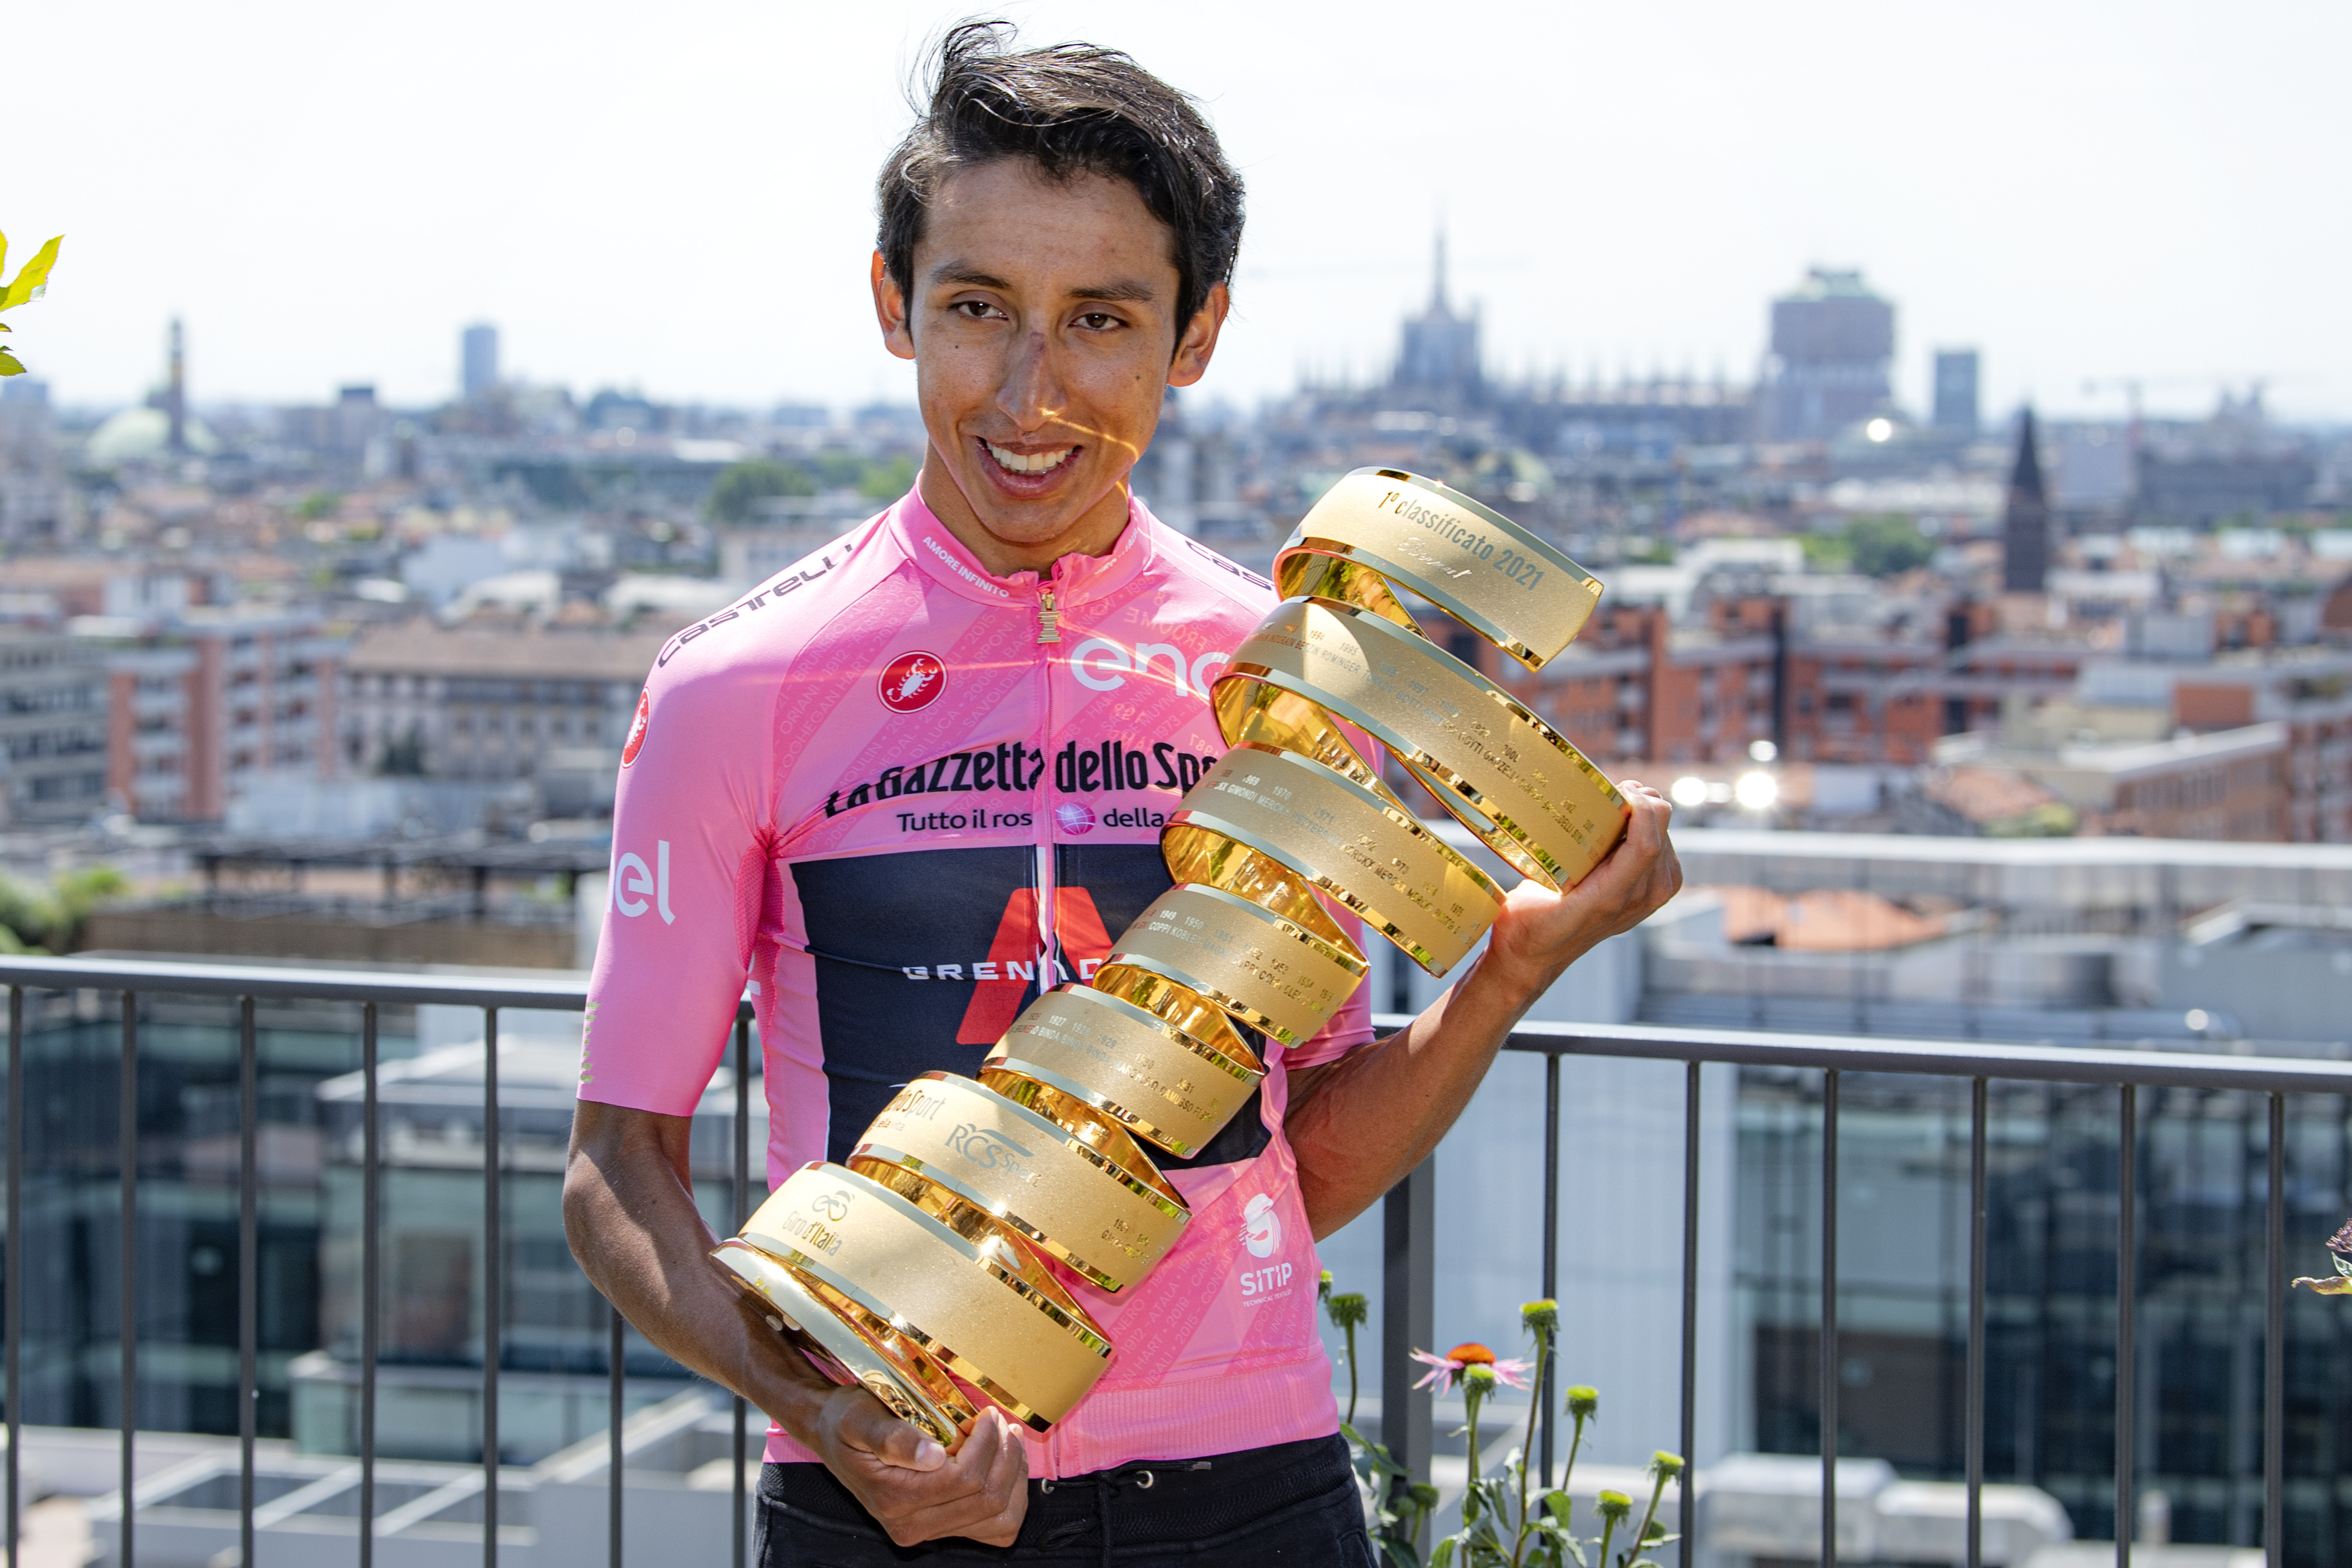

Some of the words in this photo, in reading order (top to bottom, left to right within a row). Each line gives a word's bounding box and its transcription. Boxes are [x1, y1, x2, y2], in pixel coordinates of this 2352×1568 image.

[1395, 499, 1495, 561] classificato
[1492, 549, 1545, 591] 2021
[923, 536, 960, 571] AMORE
[957, 566, 1010, 597] INFINITO
[965, 613, 996, 645] 2015
[1340, 641, 1359, 656] 1995
[836, 653, 871, 691] HART
[950, 620, 1018, 689] SCARPONI
[1321, 649, 1361, 675] ROMINGER
[780, 684, 821, 734] ORIANI
[821, 649, 848, 677] 1912
[910, 743, 929, 760] DI
[923, 709, 962, 744] LUCA
[963, 667, 999, 702] 2006
[1056, 740, 1149, 793] dello
[1227, 784, 1258, 802] GIMONDI
[1272, 785, 1293, 801] 1970
[897, 812, 966, 832] Tutto
[972, 809, 987, 829] il
[1102, 808, 1163, 828] della
[607, 838, 676, 926] el
[1148, 921, 1172, 934] COPPI
[1159, 909, 1178, 920] 1949
[1183, 916, 1204, 930] 1950
[1048, 1014, 1068, 1027] 1927
[1037, 1026, 1062, 1042] BINDA
[1158, 1085, 1194, 1113] CAMUSSO
[902, 1089, 948, 1121] Sport
[944, 1123, 1003, 1169] RCS
[999, 1151, 1042, 1187] Sport
[782, 1210, 808, 1236] Giro
[801, 1221, 843, 1256] d'Italia
[1120, 1328, 1144, 1355] 1912
[1149, 1281, 1180, 1323] ATALA
[1133, 1333, 1163, 1370] HART
[1166, 1296, 1190, 1328] 2019
[1175, 1313, 1198, 1346] 2015
